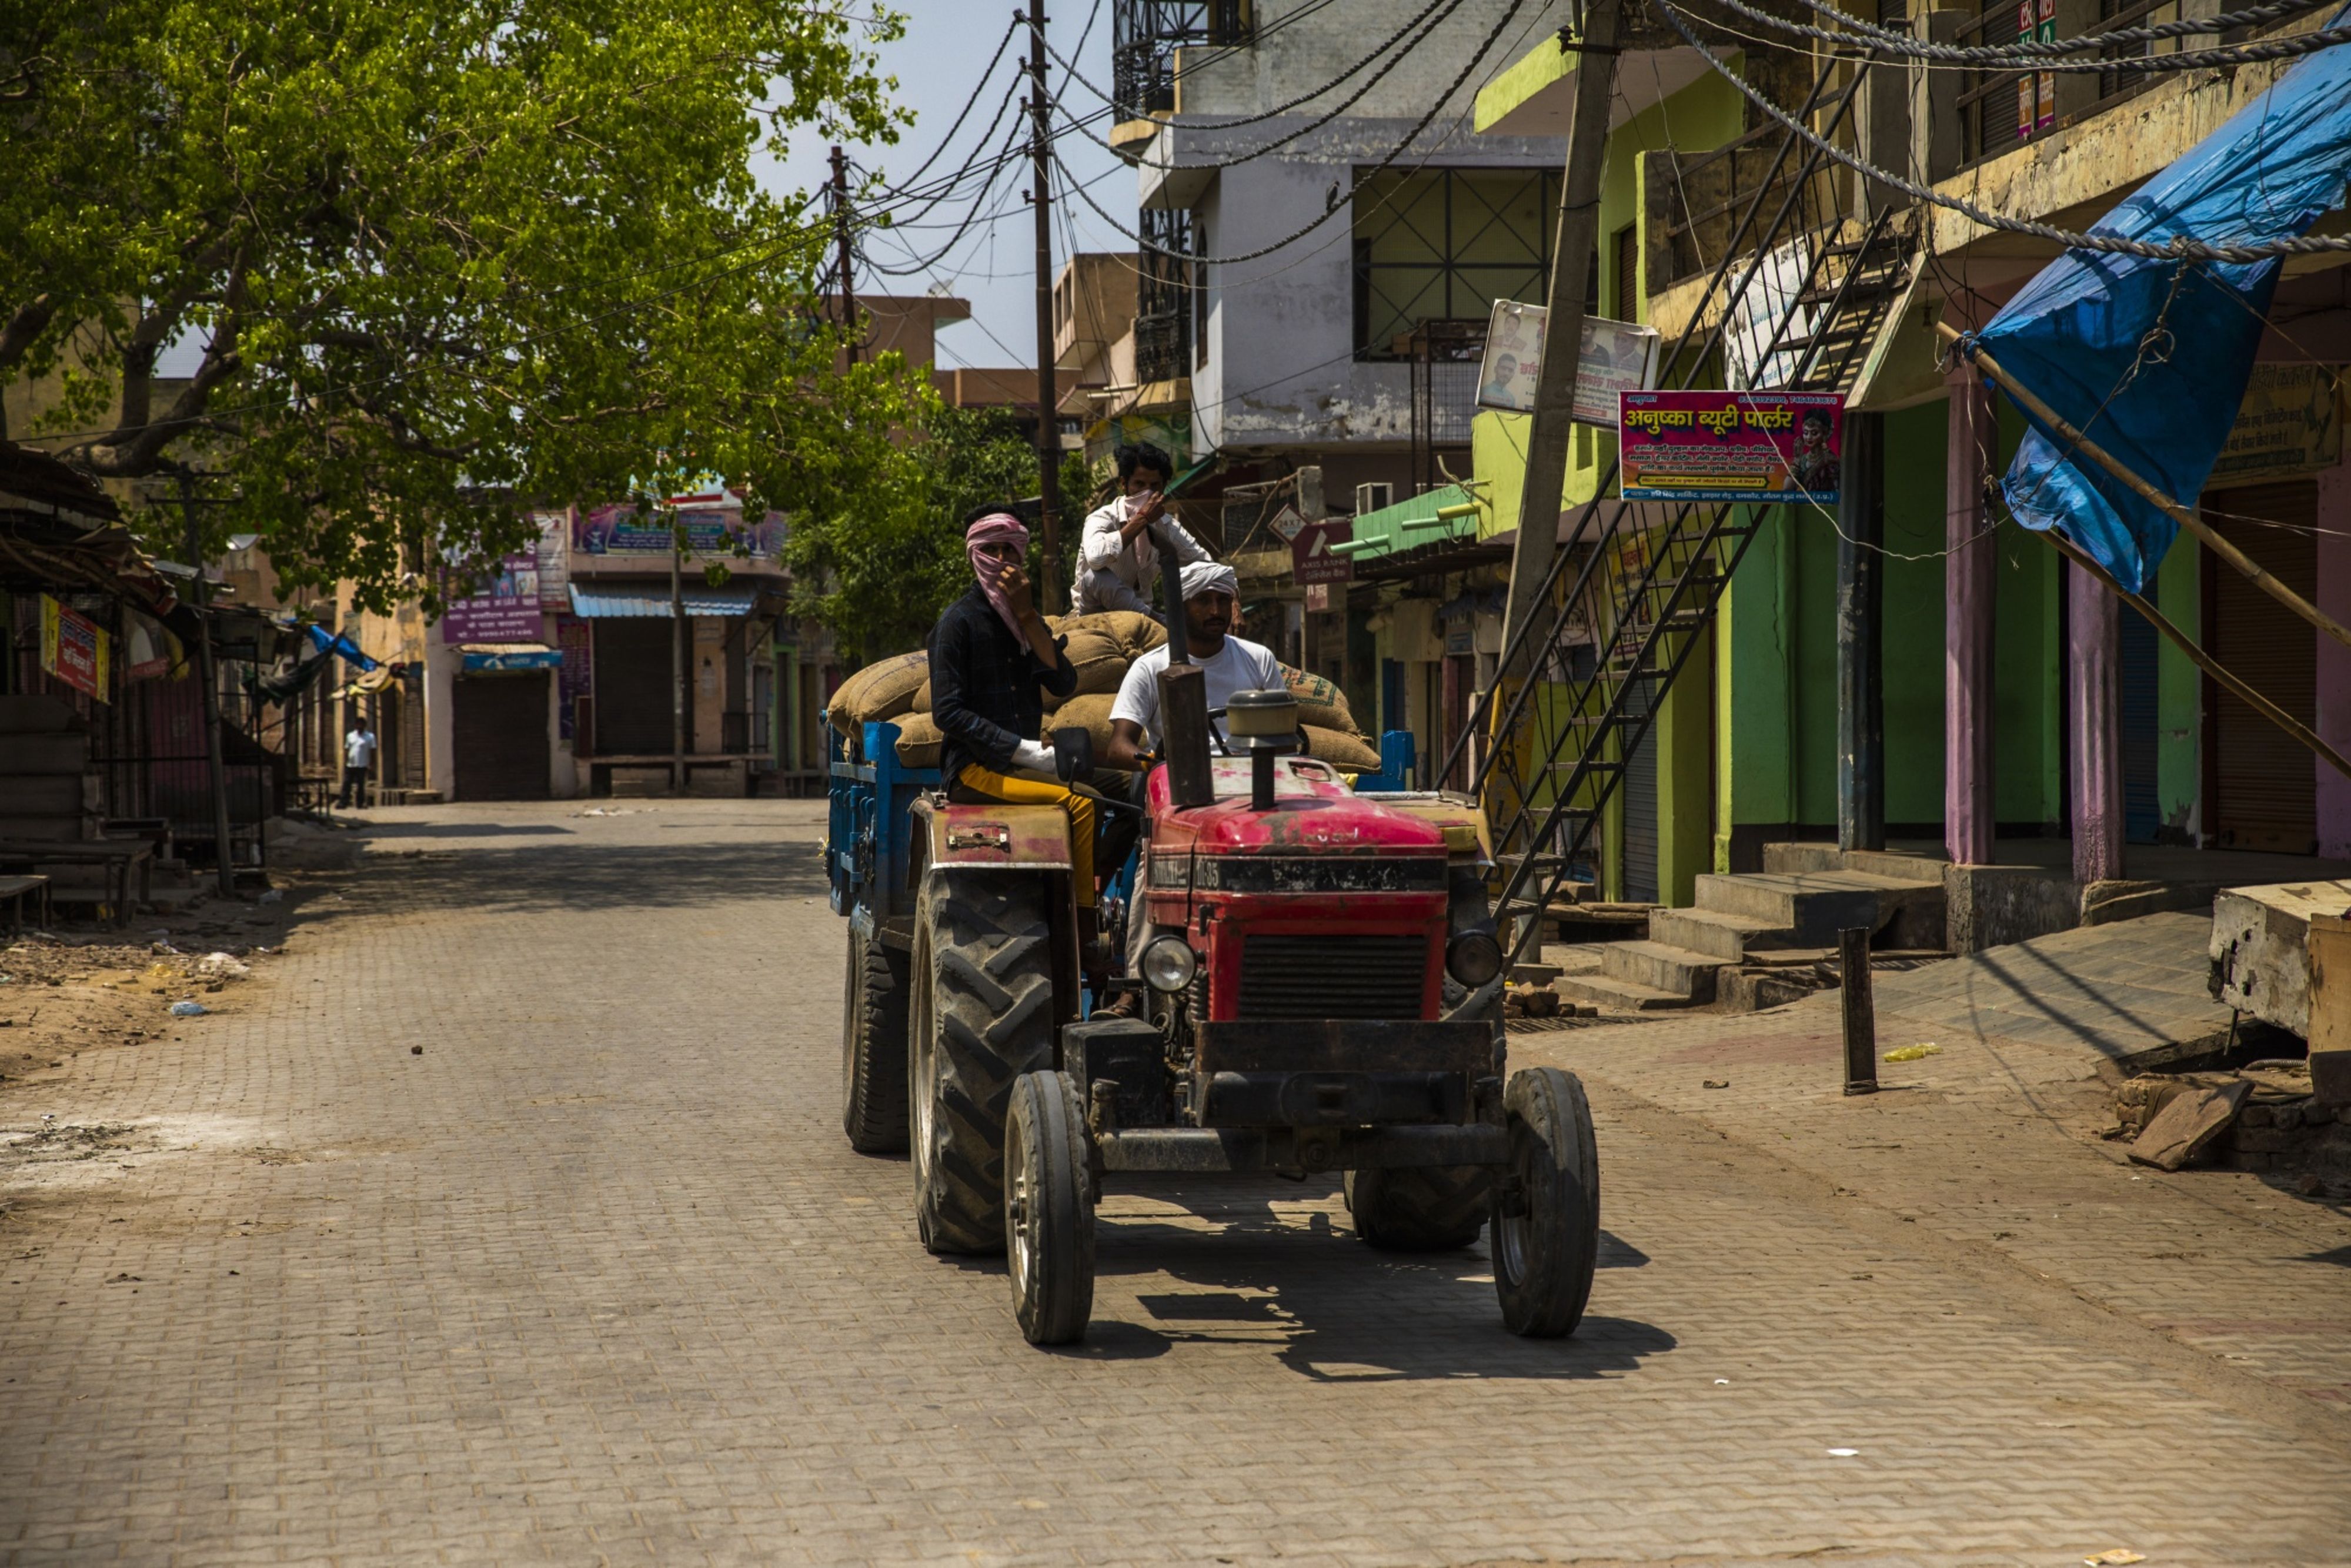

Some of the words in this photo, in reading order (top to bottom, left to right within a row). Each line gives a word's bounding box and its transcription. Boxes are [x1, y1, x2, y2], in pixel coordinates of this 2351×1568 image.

[1625, 410, 1694, 434] अनुष्का
[1698, 404, 1739, 434] ब्यूटी
[1744, 405, 1794, 429] पार्लर
[1301, 560, 1321, 569] AXIS
[1323, 559, 1348, 567] BANK
